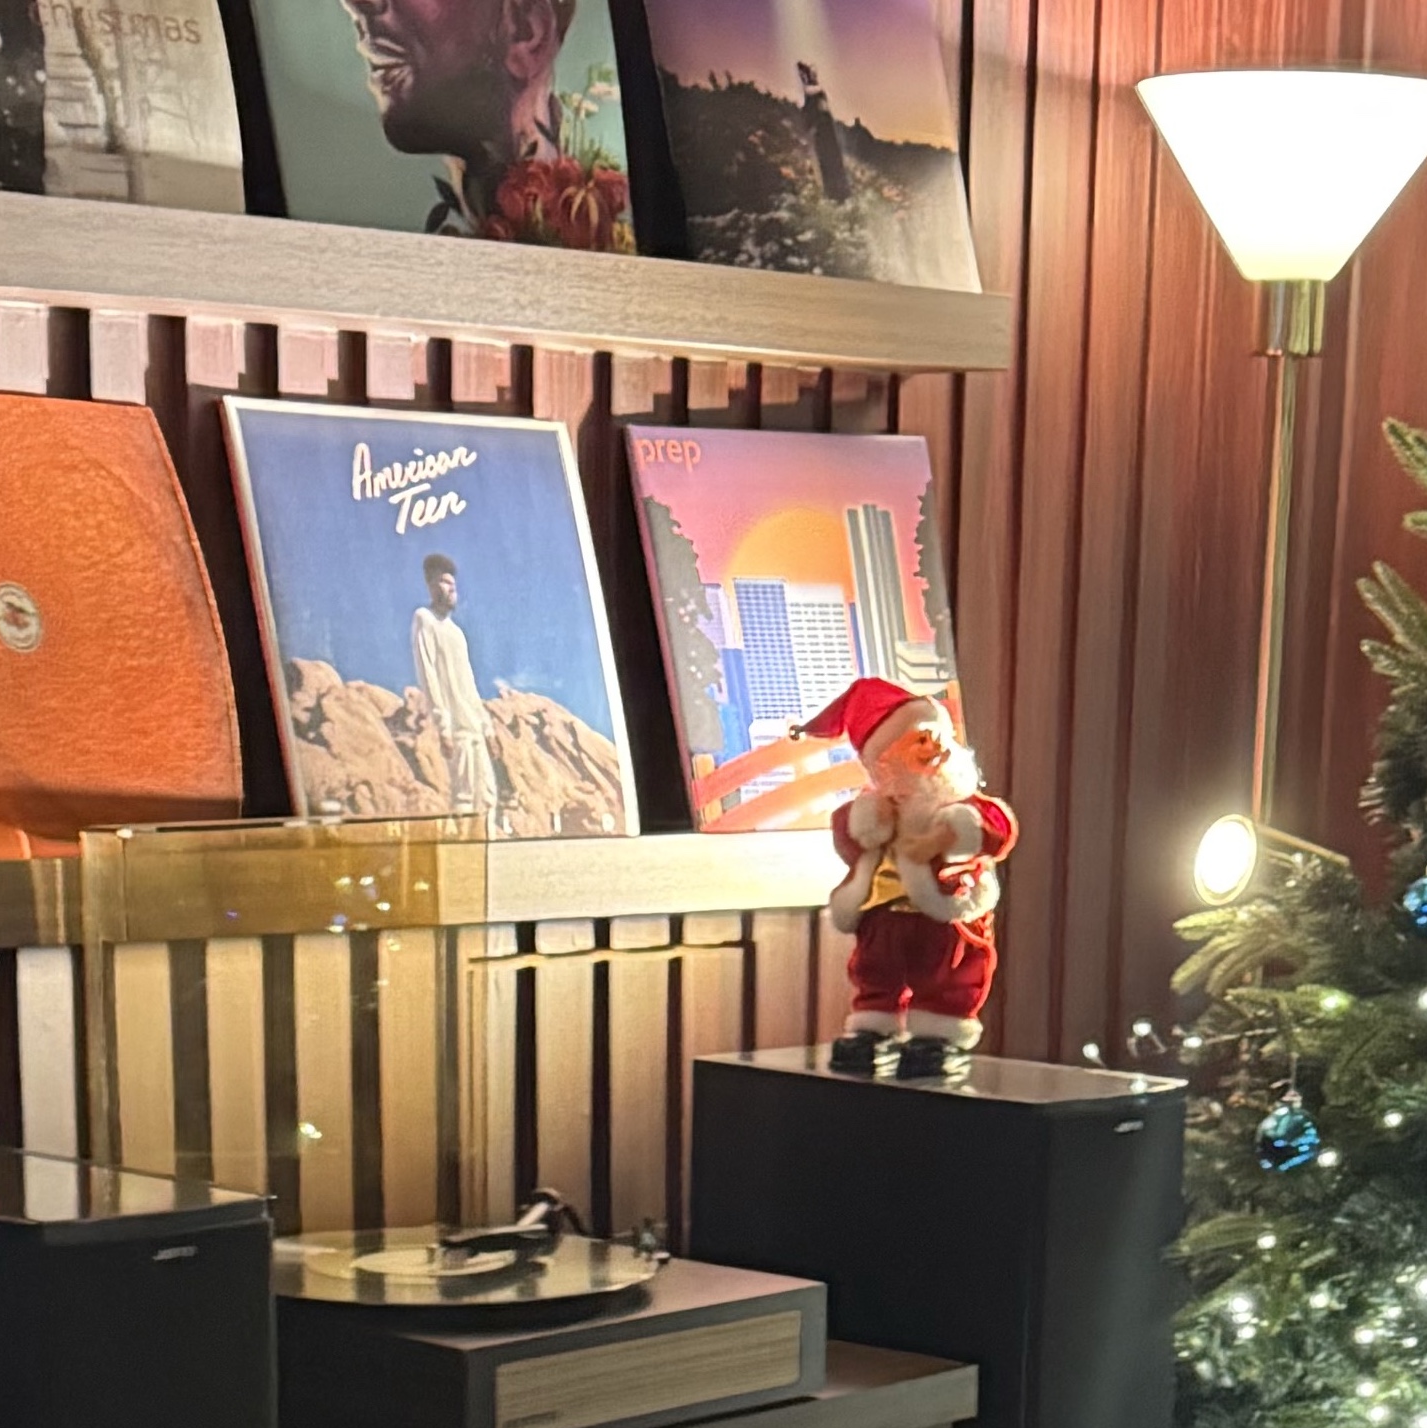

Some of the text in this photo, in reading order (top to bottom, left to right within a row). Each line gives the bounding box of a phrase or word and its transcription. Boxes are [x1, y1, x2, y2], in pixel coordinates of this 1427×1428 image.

[352, 442, 478, 501] American
[634, 438, 702, 474] prep
[389, 483, 466, 535] Teen
